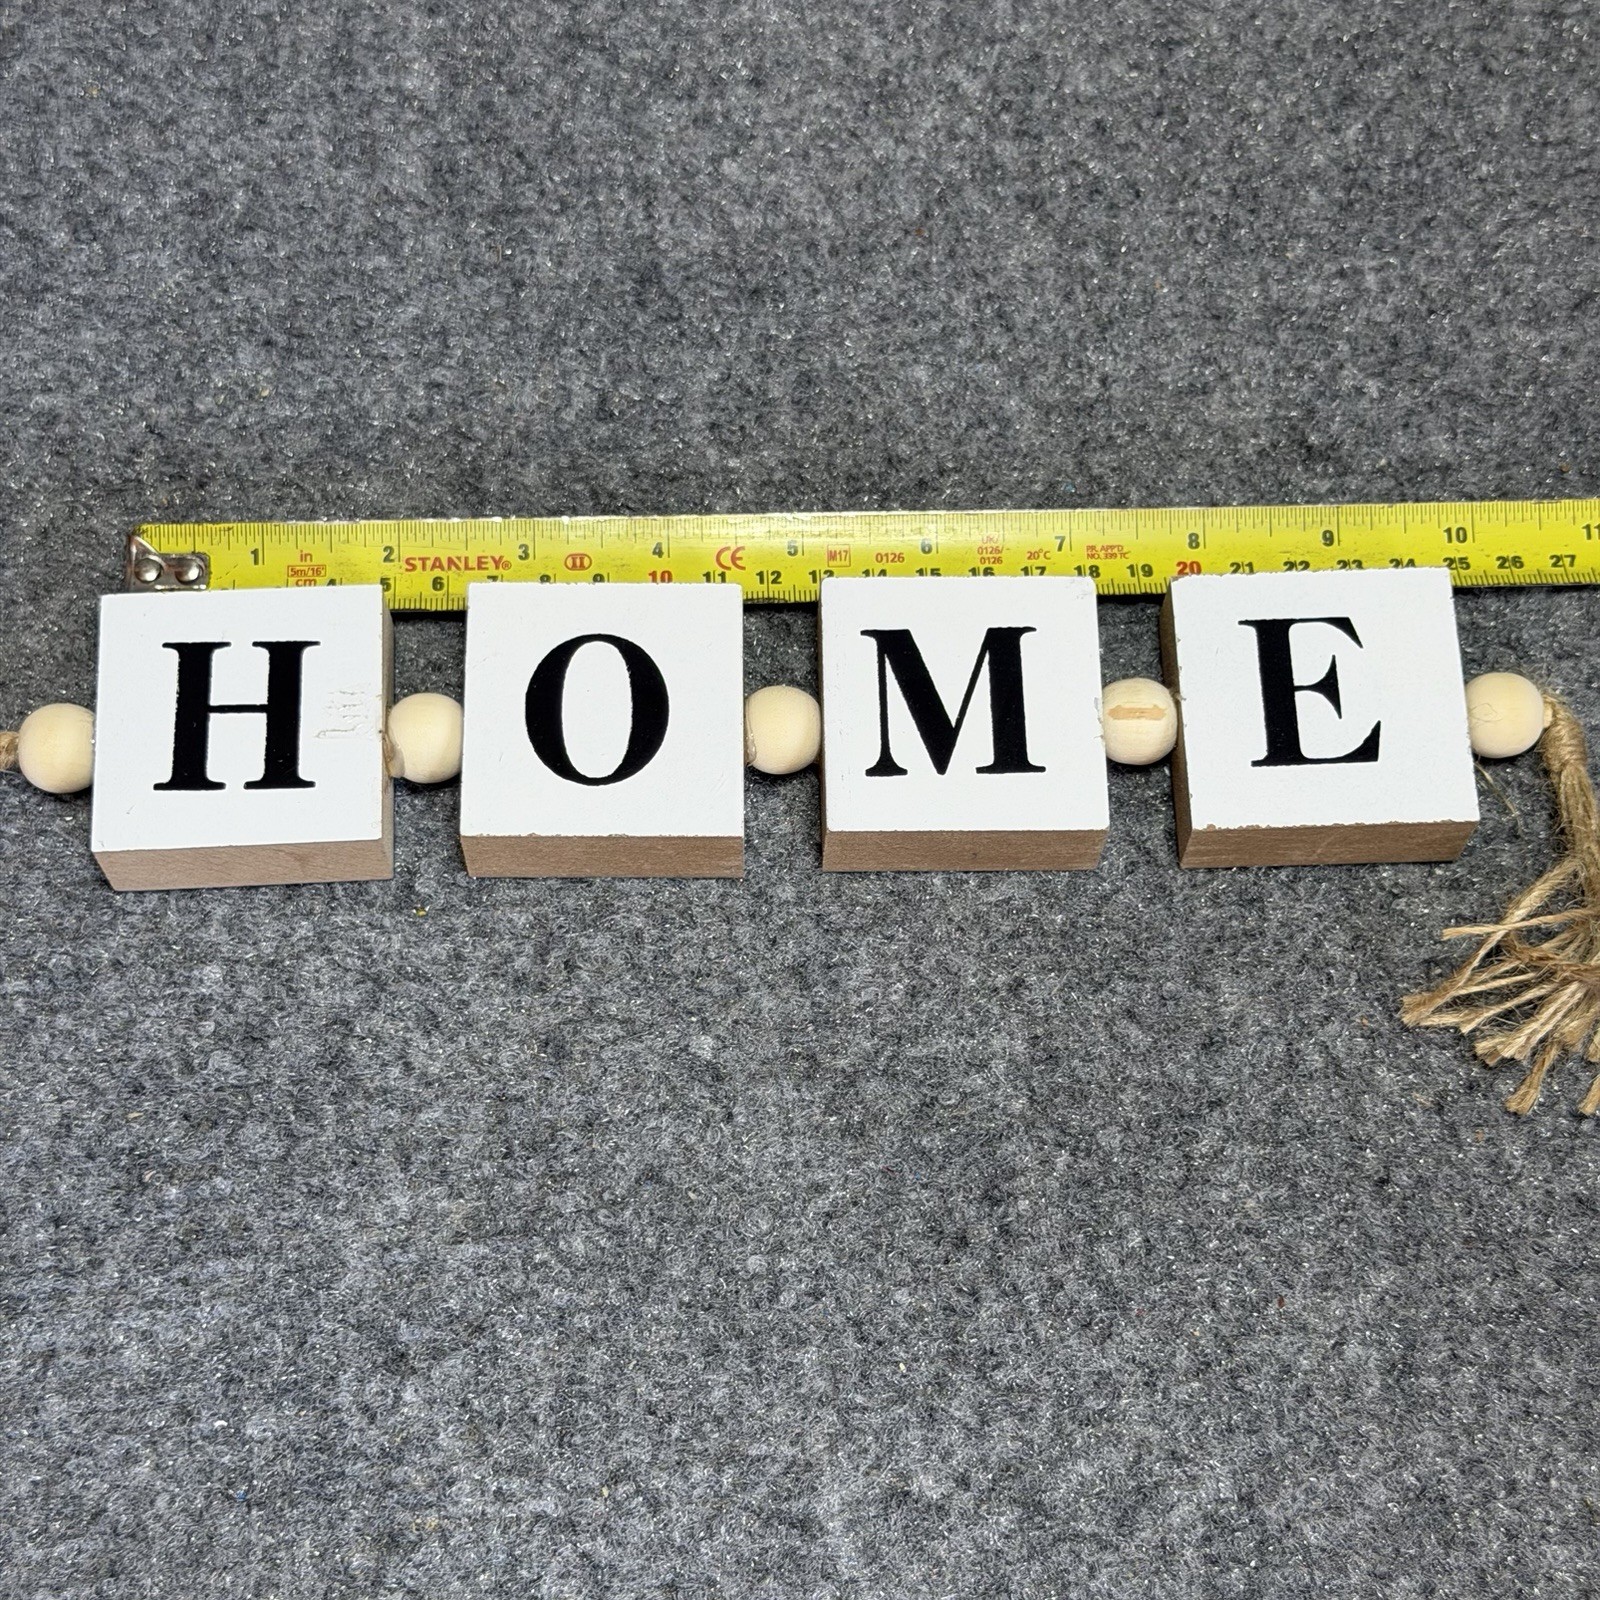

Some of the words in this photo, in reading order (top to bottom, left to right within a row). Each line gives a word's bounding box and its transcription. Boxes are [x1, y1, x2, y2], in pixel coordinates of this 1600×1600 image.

[1187, 533, 1200, 550] 8
[1322, 529, 1335, 547] 9
[1443, 526, 1468, 544] 10
[651, 542, 664, 559] 4
[787, 540, 798, 557] 5
[920, 538, 933, 555] 6
[1054, 535, 1066, 552] 7
[250, 548, 260, 566] 1
[300, 550, 313, 563] in
[382, 545, 395, 563] 2
[517, 543, 530, 561] 3
[875, 552, 905, 564] 0126
[980, 556, 1003, 565] 0126
[1442, 557, 1471, 571] 25
[1496, 556, 1524, 570] 26
[1550, 555, 1576, 568] 27
[1073, 565, 1101, 578] 18
[1126, 564, 1153, 578] 19
[1176, 561, 1202, 576] 20
[380, 577, 392, 592] 5
[432, 576, 445, 592] 6
[648, 571, 673, 583] 10
[756, 571, 782, 585] 12
